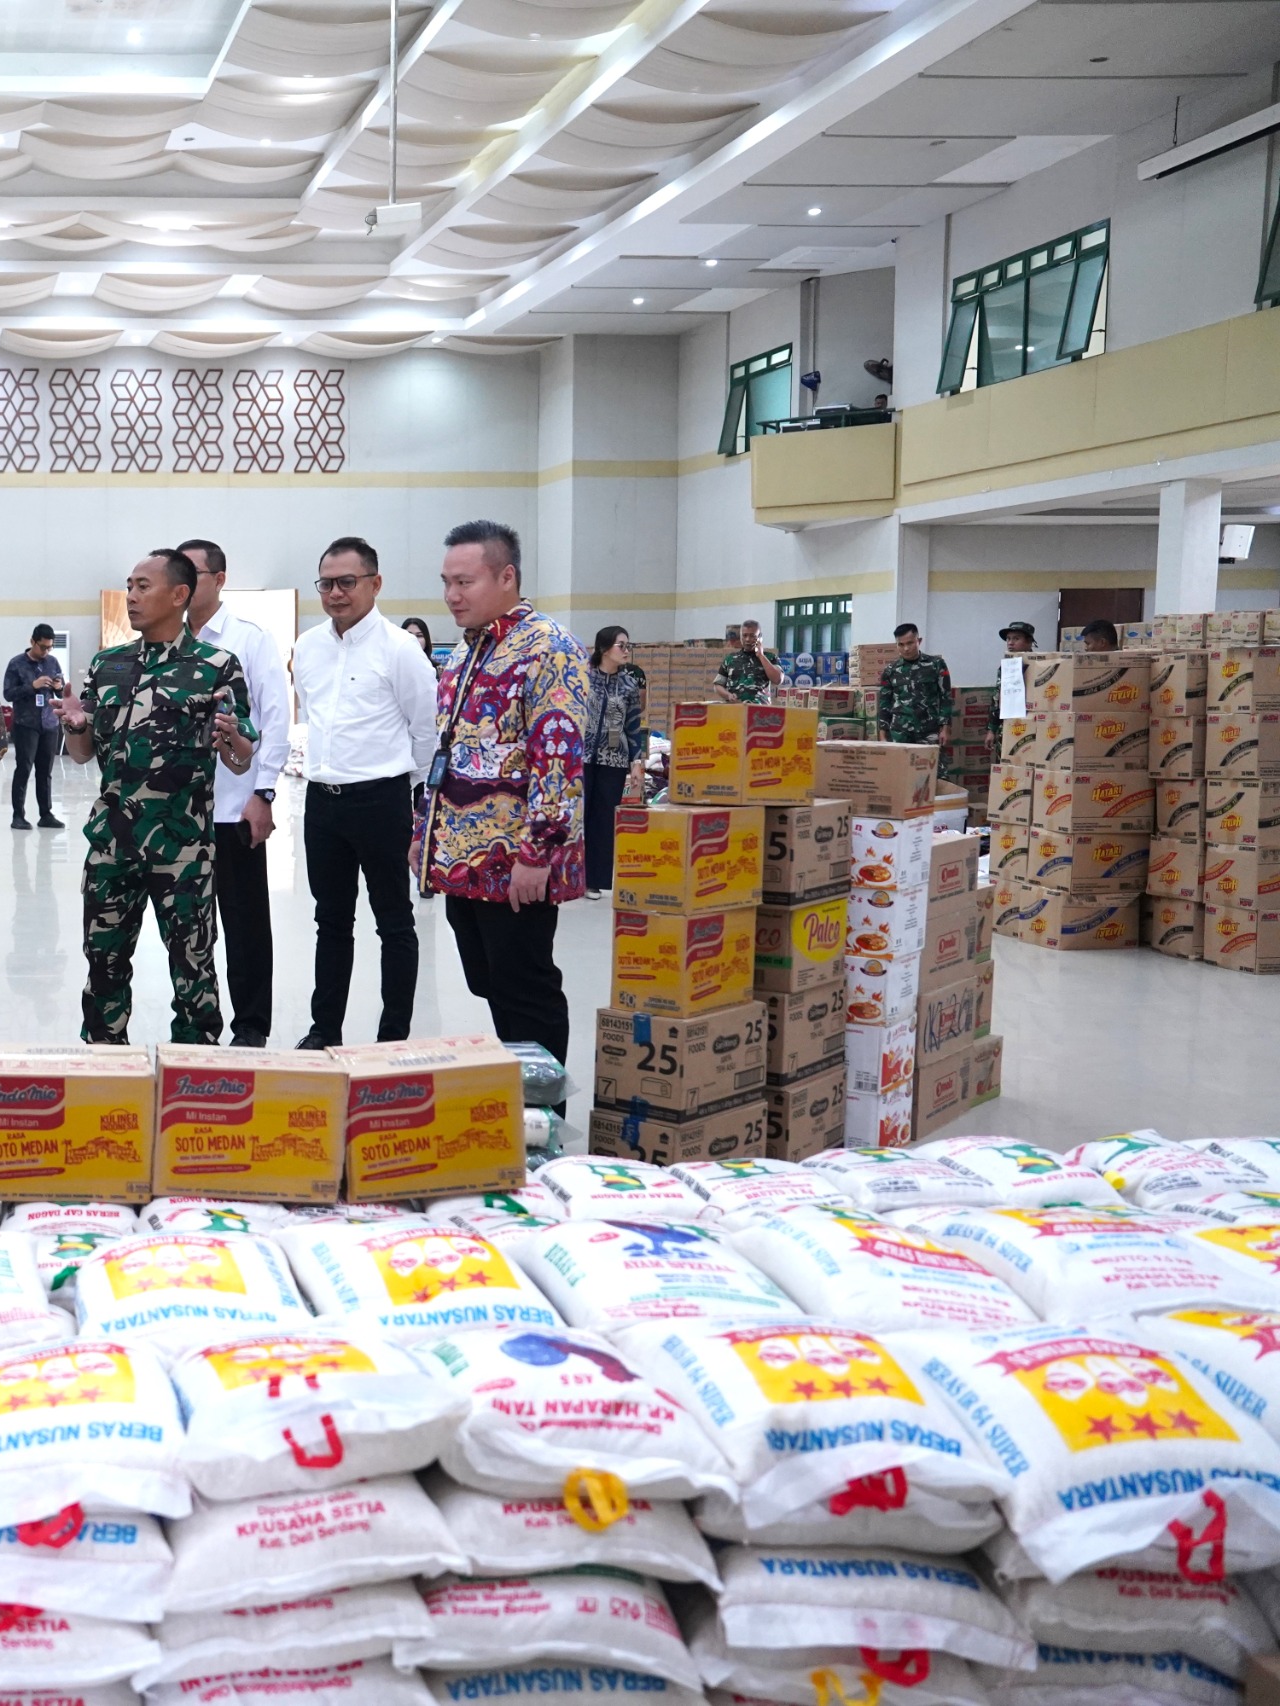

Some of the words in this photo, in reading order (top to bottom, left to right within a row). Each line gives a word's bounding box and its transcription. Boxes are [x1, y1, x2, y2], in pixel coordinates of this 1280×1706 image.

[1094, 721, 1126, 739] HATARI
[1091, 784, 1124, 802] HATARI
[1092, 845, 1124, 862] HATARI
[803, 912, 841, 951] Palco
[603, 1032, 624, 1043] FOODS
[745, 1019, 763, 1046] 25
[637, 1042, 678, 1076] 25
[11, 1117, 39, 1127] Instan
[186, 1111, 197, 1120] Mi
[199, 1111, 227, 1122] Instan
[370, 1120, 381, 1129] Mi
[382, 1118, 410, 1128] Instan
[744, 1119, 763, 1145] 25
[21, 1140, 59, 1155] MEDAN
[175, 1136, 204, 1152] SOTO
[208, 1135, 245, 1150] MEDAN
[361, 1144, 390, 1161] SOTO
[394, 1136, 430, 1156] MEDAN
[100, 1304, 209, 1333] NUSANTARA
[378, 1304, 488, 1327] NUSANTARA
[492, 1304, 555, 1327] BERAS
[491, 1397, 537, 1415] TANI
[1213, 1371, 1269, 1421] SUPER
[544, 1399, 639, 1417] HARAPAN
[87, 1420, 163, 1442] BERAS
[1057, 1466, 1205, 1512] NUSANTARA
[236, 1512, 326, 1537] KP.USAHA
[331, 1500, 388, 1519] SETIA
[289, 1530, 314, 1547] Deli
[317, 1520, 372, 1540] Serdang
[757, 1556, 898, 1578] NUSANTARA
[19, 1617, 72, 1633] SETIA
[444, 1667, 583, 1701] NUSANTARA
